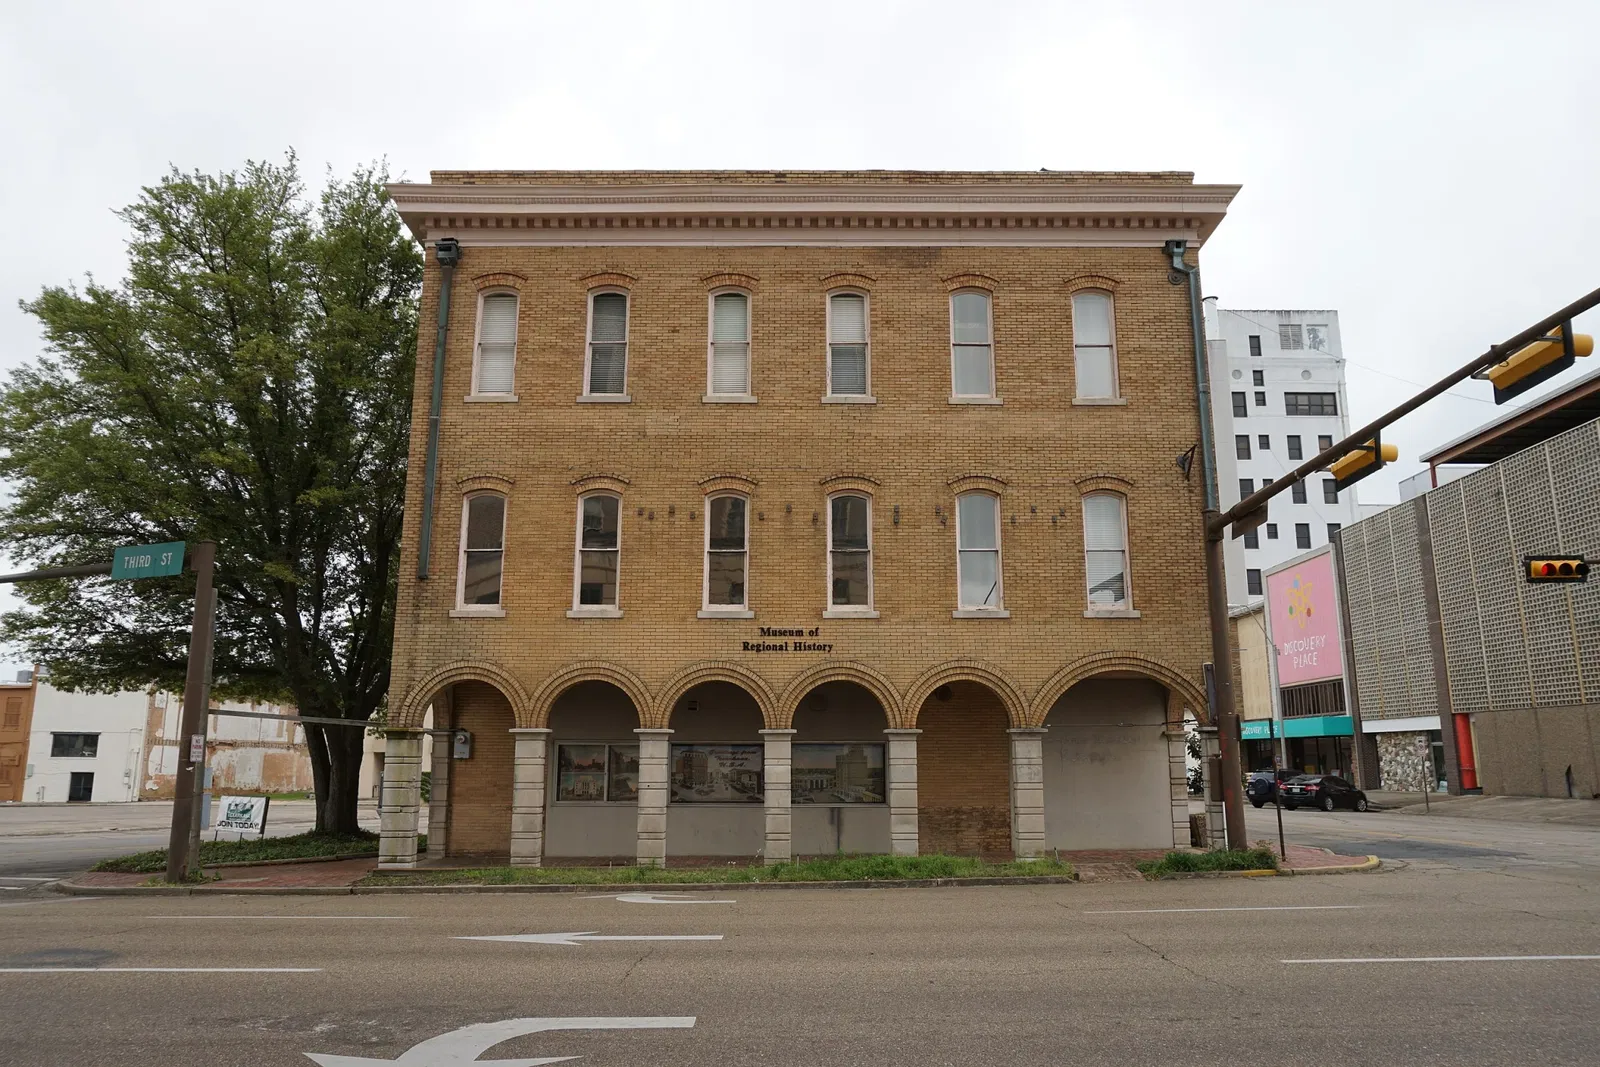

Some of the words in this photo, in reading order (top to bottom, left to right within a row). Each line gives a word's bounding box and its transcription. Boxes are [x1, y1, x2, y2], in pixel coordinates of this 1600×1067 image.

[124, 555, 151, 569] THIRD
[160, 552, 173, 566] ST
[759, 627, 804, 637] Museum
[808, 627, 820, 637] of
[742, 641, 788, 652] Regional
[793, 641, 833, 652] History
[1283, 634, 1326, 656] DISCOVERY
[1293, 651, 1318, 669] PLACE
[217, 820, 233, 828] JOIN
[234, 821, 259, 829] TODAY!
